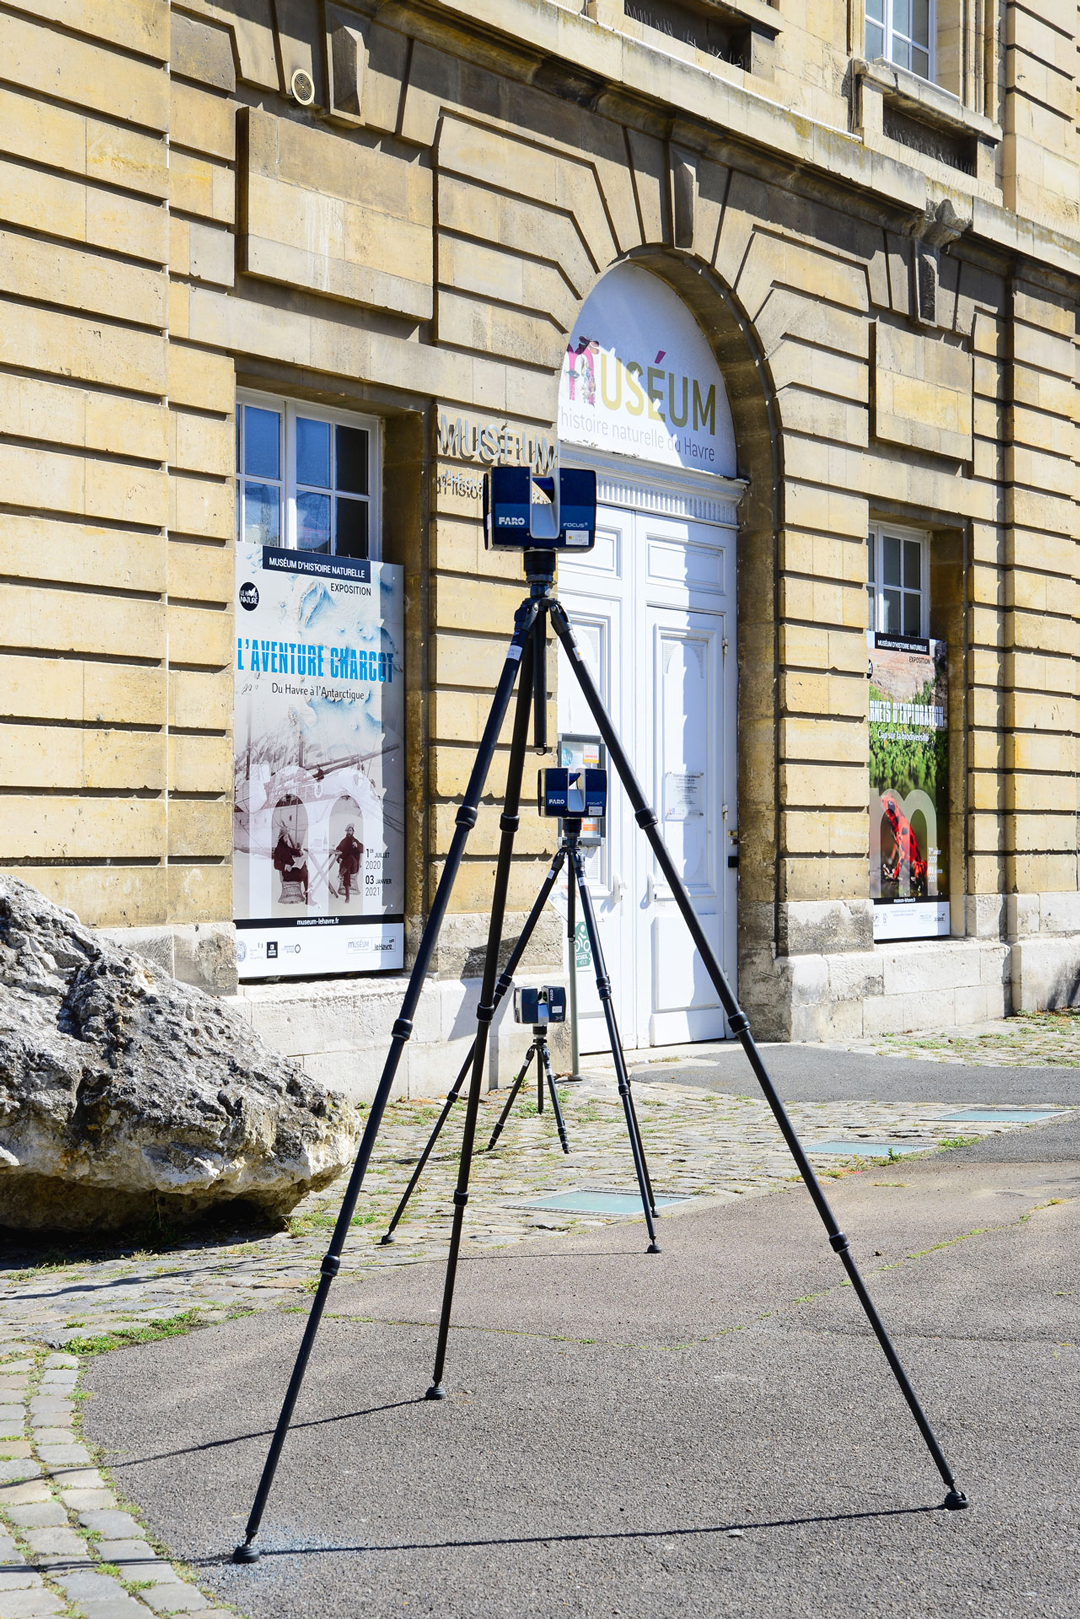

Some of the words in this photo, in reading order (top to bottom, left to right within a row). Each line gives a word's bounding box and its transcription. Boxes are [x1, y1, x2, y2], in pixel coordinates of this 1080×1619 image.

[612, 423, 664, 449] naturelle
[668, 434, 681, 453] du
[684, 437, 715, 461] Havre
[498, 516, 526, 526] FARO
[269, 557, 297, 569] MUSÉUM
[298, 561, 332, 574] D'HISTOIRE
[332, 565, 365, 579] NATURELLE
[330, 582, 372, 596] EXPOSITION
[237, 637, 324, 677] L'AVENTURE
[330, 647, 394, 683] CHARCOT
[909, 656, 931, 665] EXPOSITION
[271, 682, 283, 694] Du
[285, 684, 308, 696] Havre
[310, 685, 315, 696] à
[316, 686, 365, 702] l'Antarctique
[893, 702, 944, 727] D'EXPLORATION
[878, 730, 887, 740] Cap
[902, 731, 929, 742] biodiversité
[365, 860, 382, 870] 2020
[365, 875, 374, 885] 03
[365, 886, 380, 897] 2021
[296, 917, 340, 926] museum-lehavre.fr
